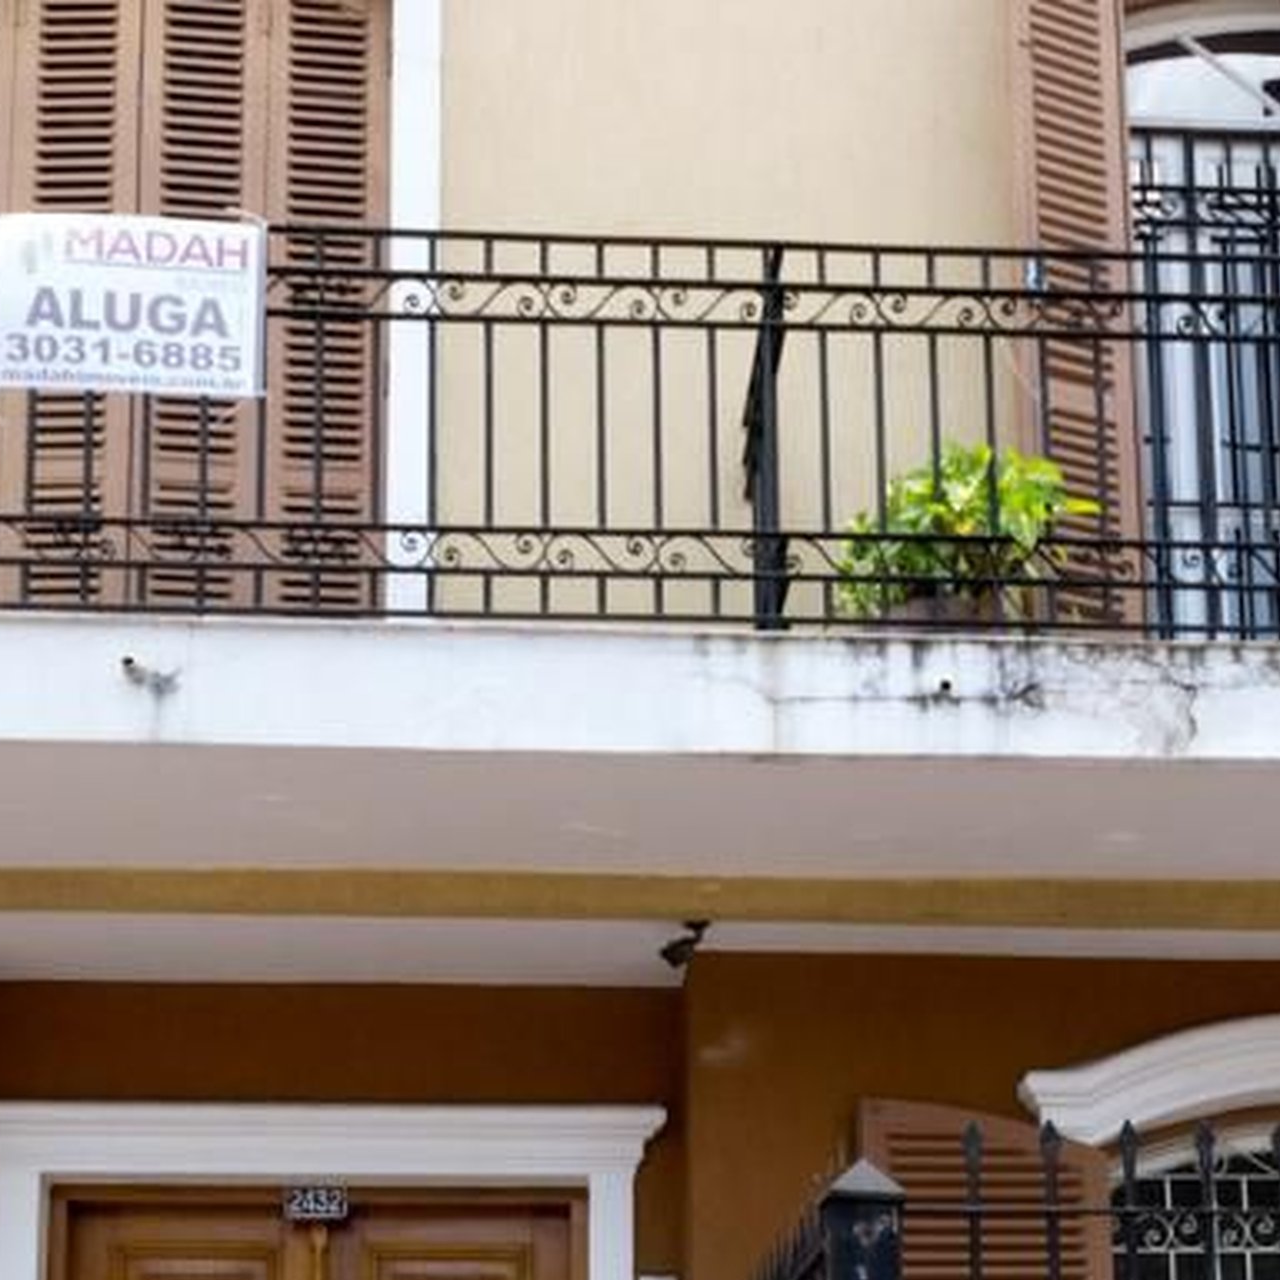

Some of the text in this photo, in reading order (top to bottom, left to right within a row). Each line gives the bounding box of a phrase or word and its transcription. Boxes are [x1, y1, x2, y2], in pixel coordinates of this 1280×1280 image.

[65, 228, 248, 268] MADAH
[26, 286, 228, 338] ALUGA
[5, 333, 242, 372] 3031-6885
